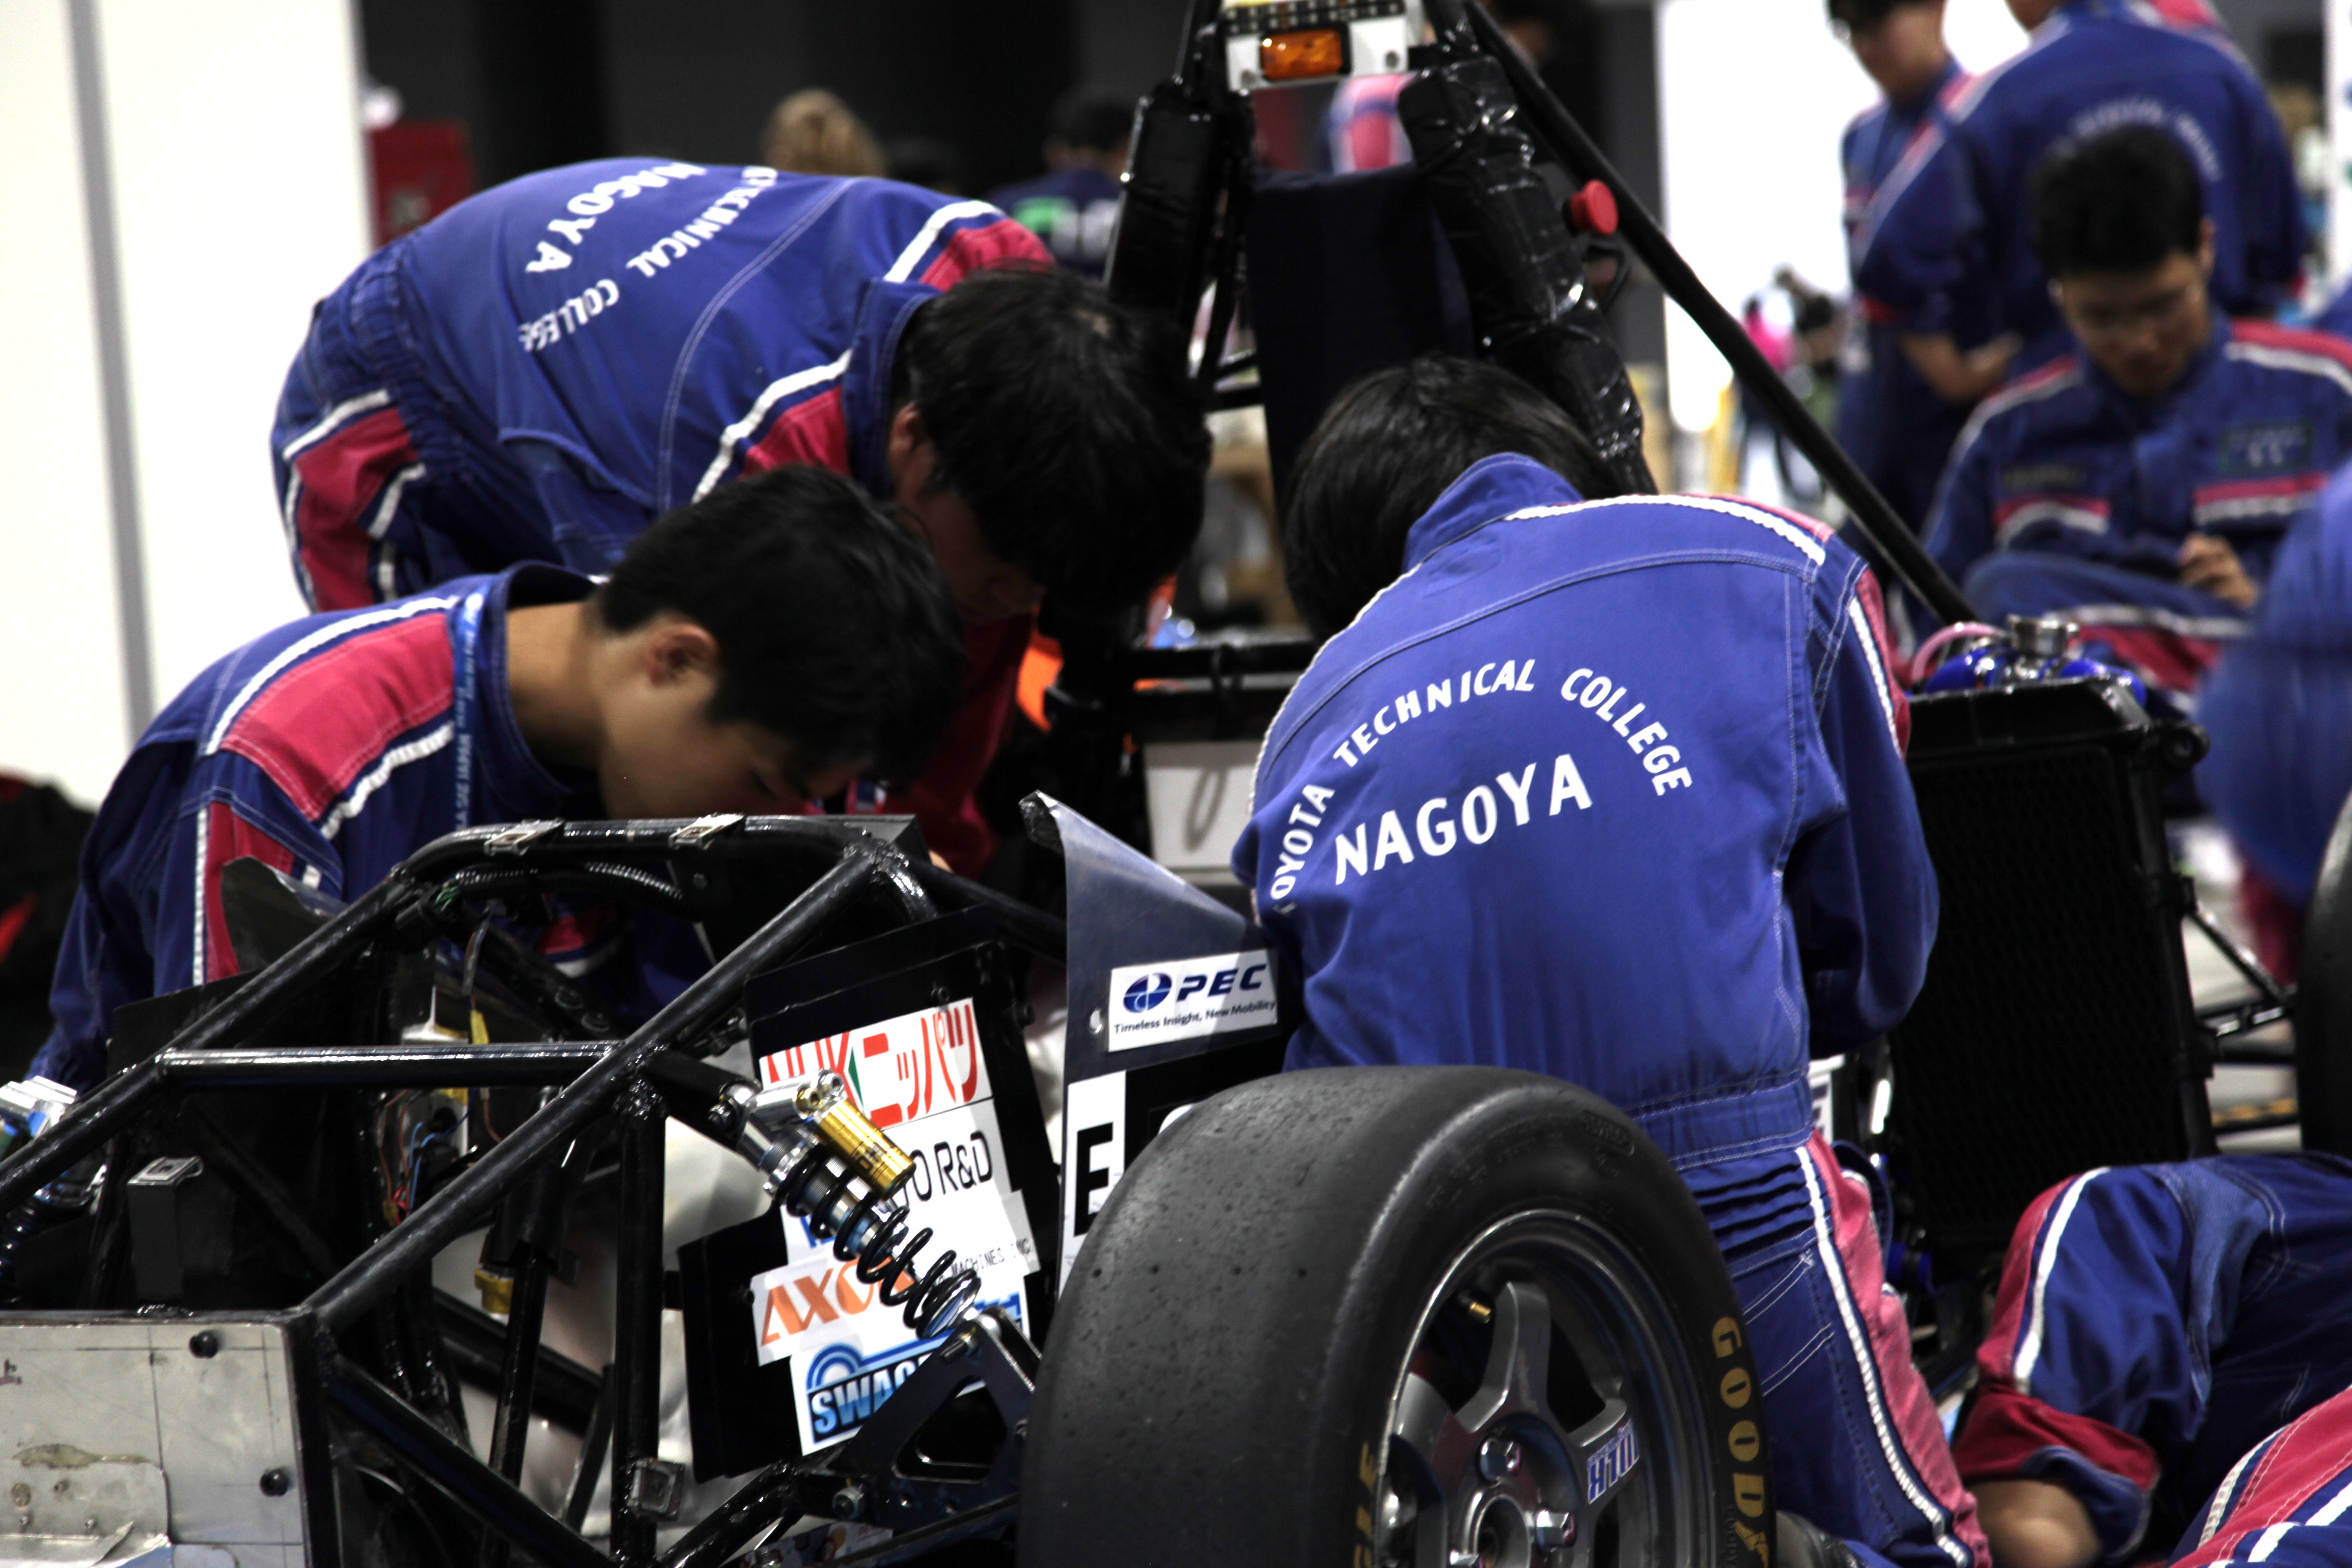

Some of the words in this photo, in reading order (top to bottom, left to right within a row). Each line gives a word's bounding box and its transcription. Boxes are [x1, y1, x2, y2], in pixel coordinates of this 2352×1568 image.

[1333, 659, 1536, 767] TECHNICAL
[1561, 668, 1693, 796] COLLEGE
[1335, 753, 1593, 885] NAGOYA
[1114, 1018, 1160, 1034] Timeless
[1163, 1011, 1202, 1027] Insight,
[1206, 1008, 1228, 1019] New
[1231, 999, 1276, 1016] Mobility
[1177, 964, 1266, 1003] PEC
[933, 1130, 993, 1195] R&D
[1712, 1317, 1764, 1518] GOOD
